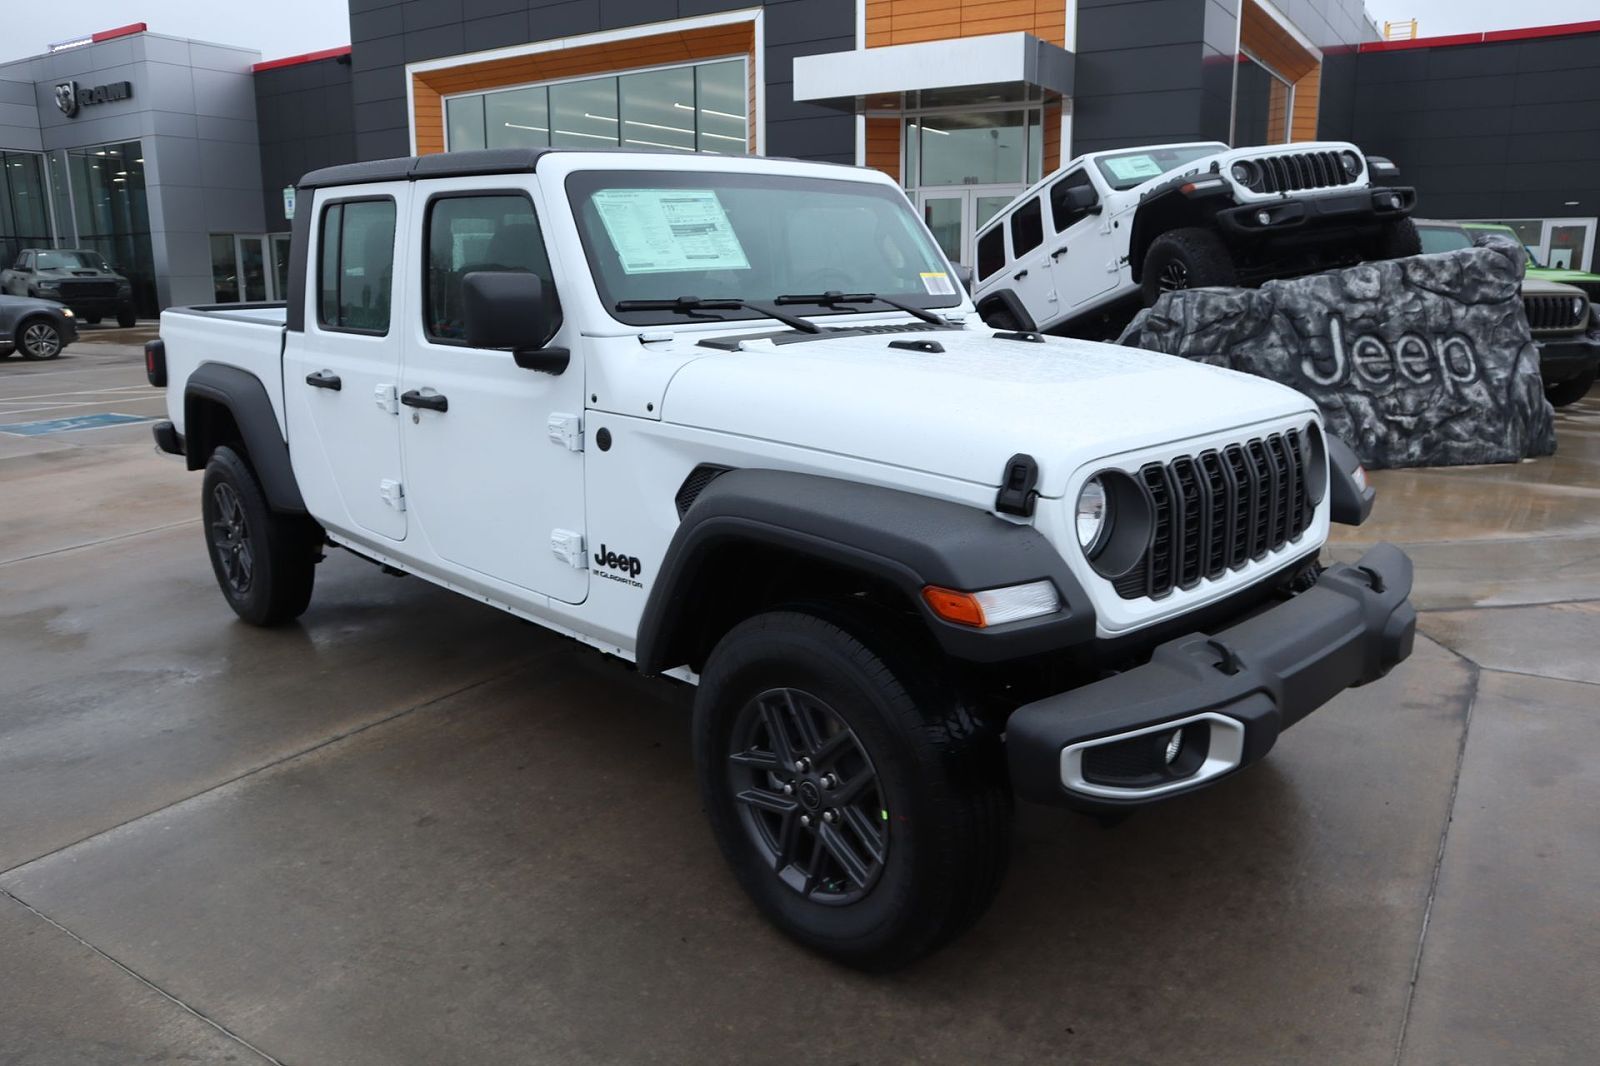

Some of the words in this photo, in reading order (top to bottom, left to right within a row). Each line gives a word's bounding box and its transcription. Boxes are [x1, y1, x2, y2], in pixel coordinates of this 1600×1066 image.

[78, 81, 132, 106] RAM
[1301, 317, 1477, 395] Jeep
[594, 544, 641, 579] Jeep
[599, 571, 643, 588] GLADIATOR
